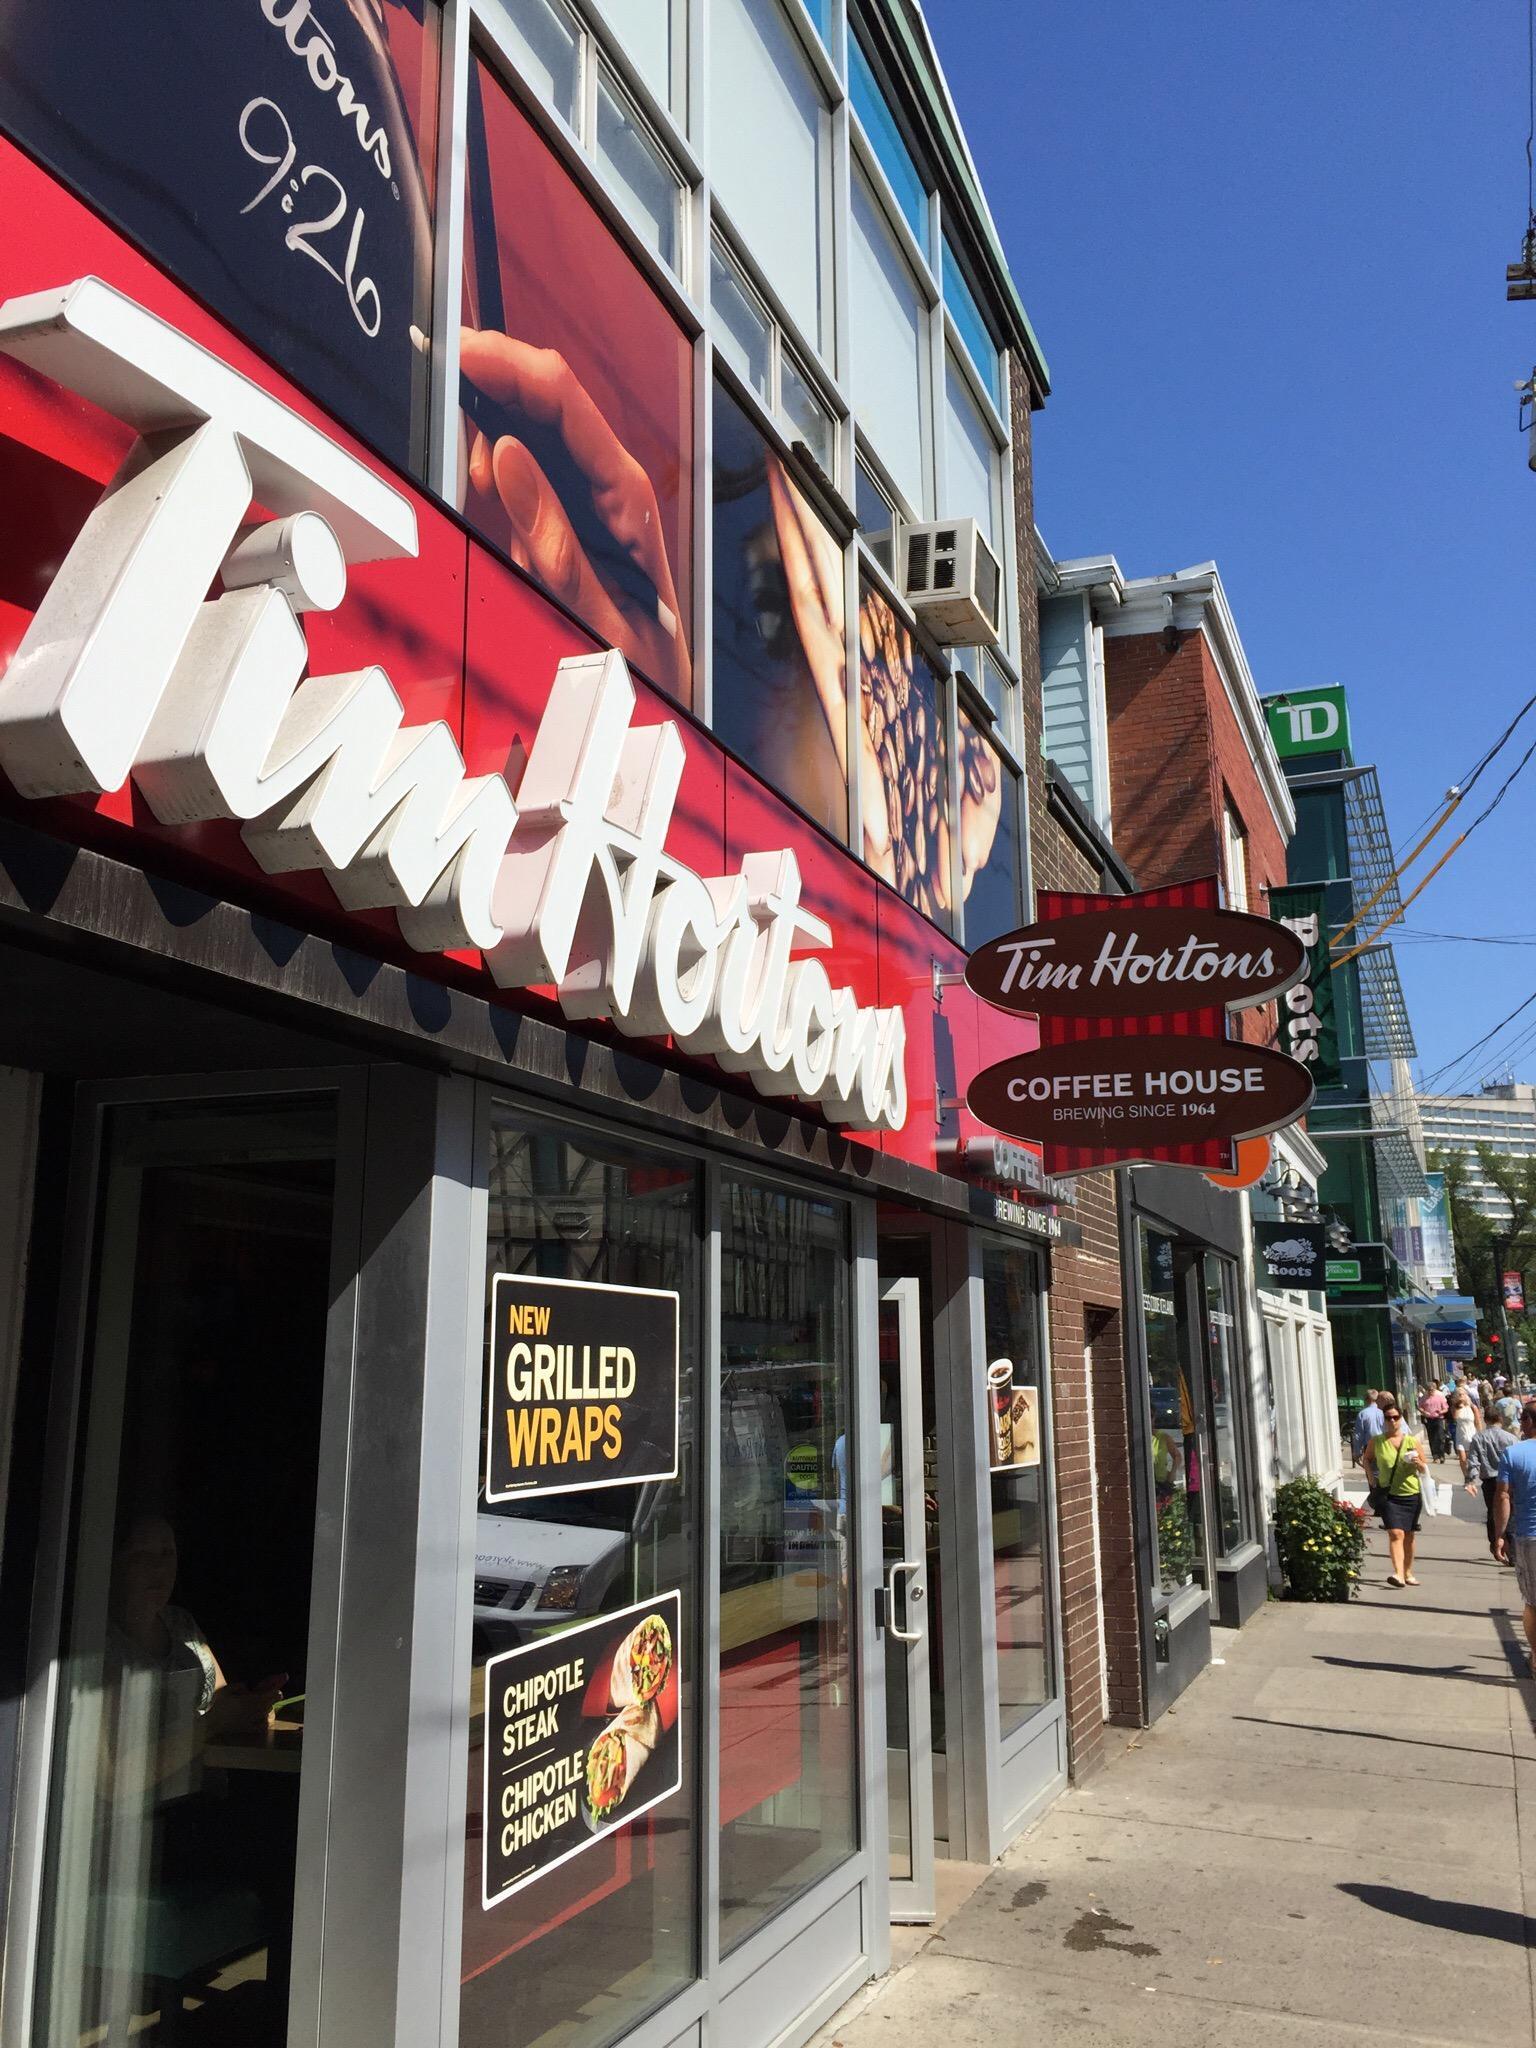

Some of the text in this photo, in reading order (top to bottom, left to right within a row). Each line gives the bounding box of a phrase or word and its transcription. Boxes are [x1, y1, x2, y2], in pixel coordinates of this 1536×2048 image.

[239, 97, 382, 337] 9:26
[50, 274, 908, 1132] Tim Hortons
[1276, 700, 1340, 744] TD
[996, 931, 1275, 994] Tim Hortons
[1280, 912, 1324, 1064] Rots
[1006, 1067, 1266, 1103] COFFEE HOUSE
[1053, 1102, 1217, 1122] BREWING SINCE 1964
[1027, 1209, 1047, 1233] SINCE
[1267, 1263, 1312, 1278] Roots
[509, 1304, 551, 1336] NEW
[506, 1342, 637, 1402] GRILLED
[506, 1404, 623, 1468] WRAPS
[503, 1657, 585, 1719] CHIPOTLE
[502, 1703, 560, 1757] STEAK
[501, 1748, 584, 1820] CHIPOTLE
[500, 1788, 577, 1858] CHICKEN
